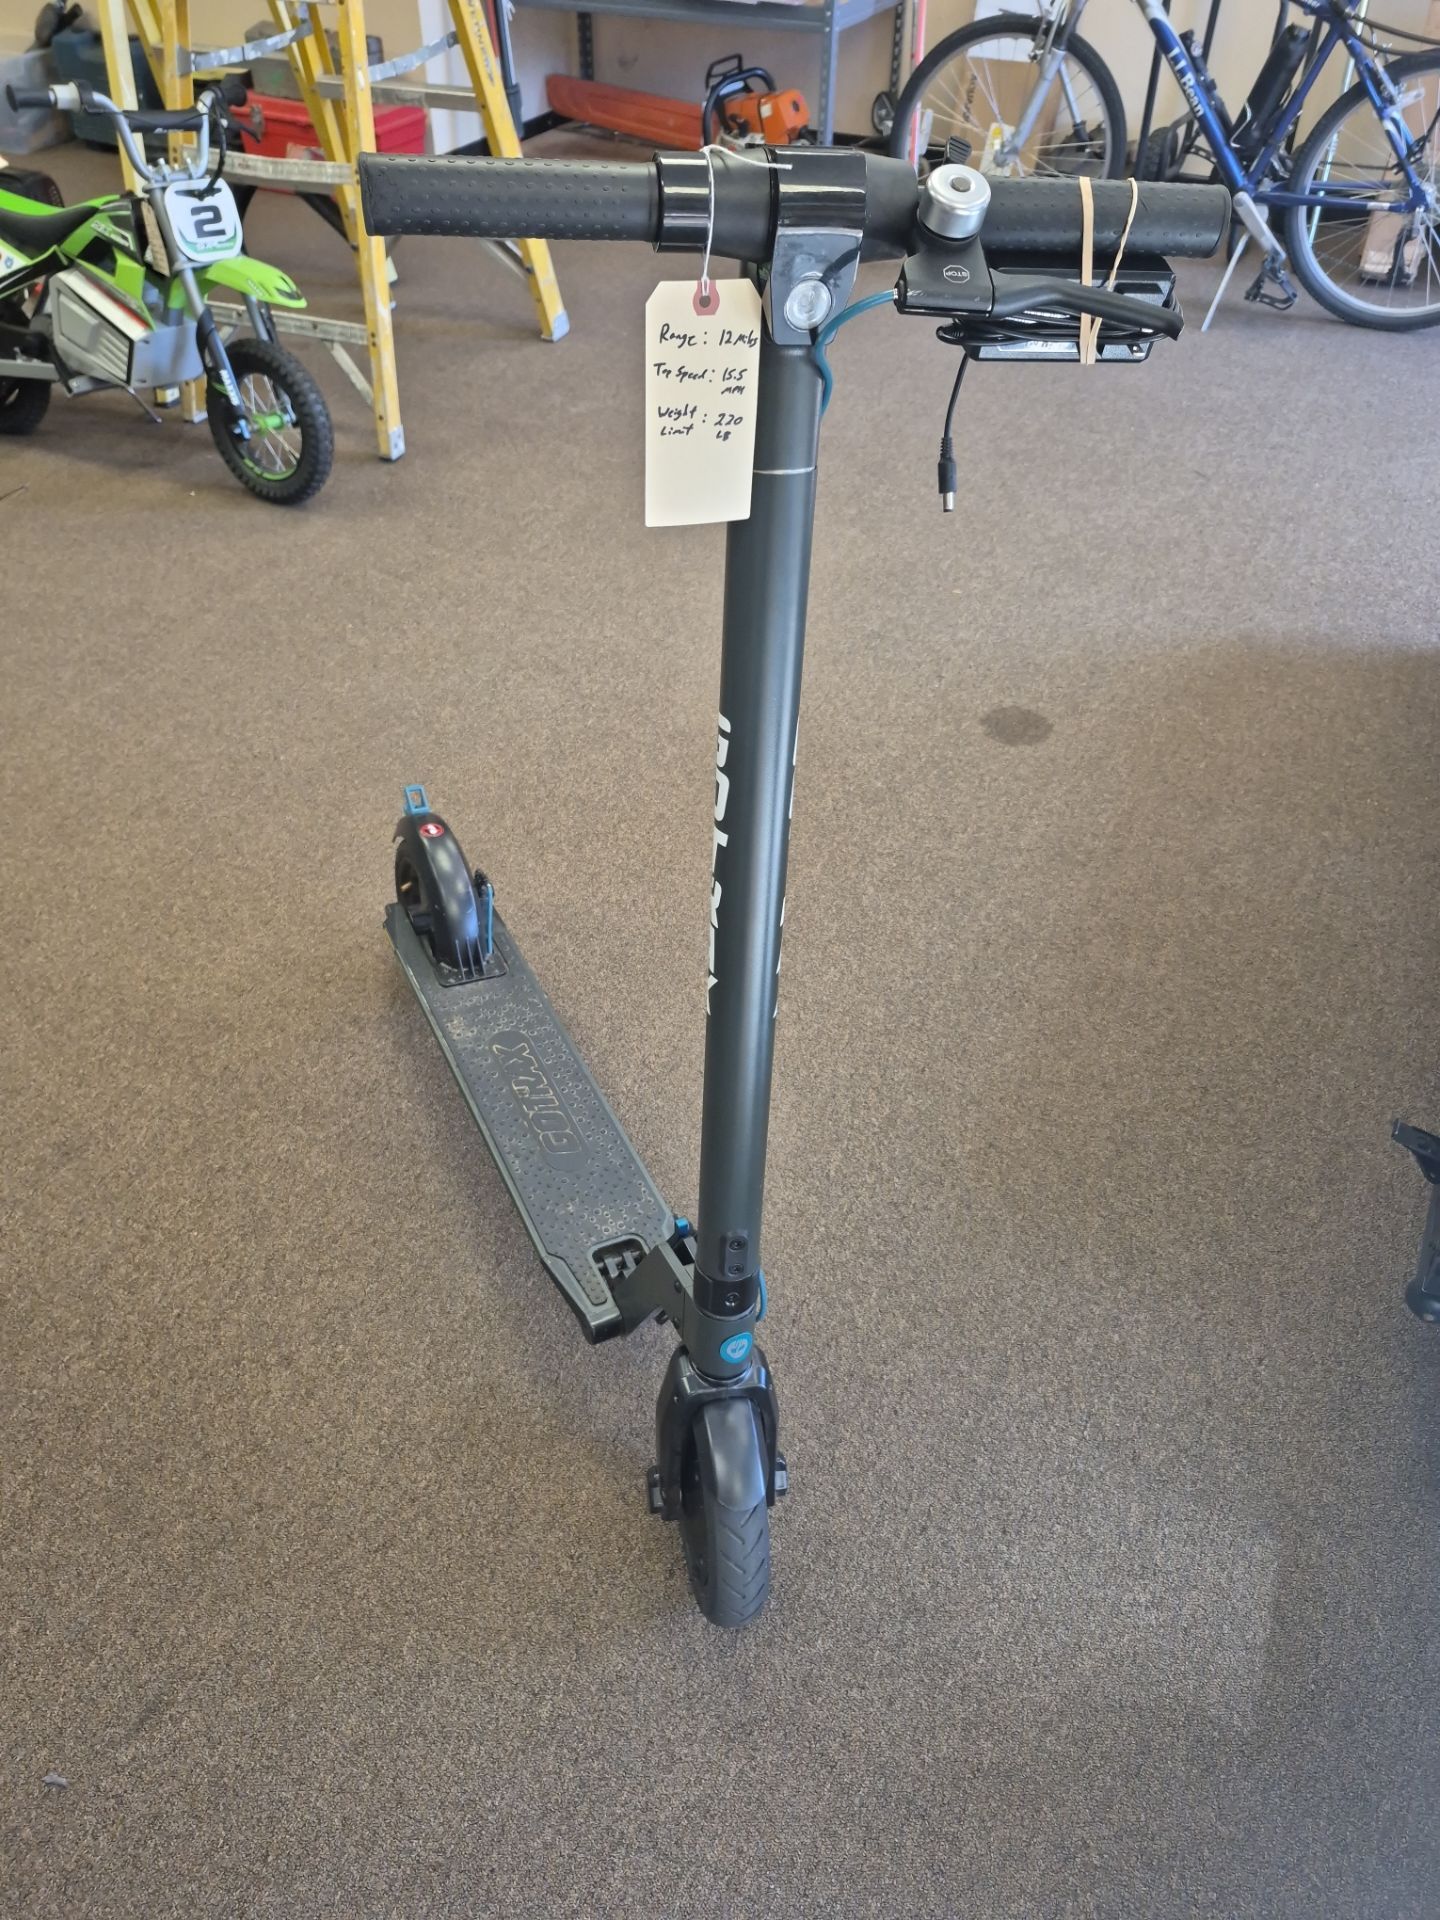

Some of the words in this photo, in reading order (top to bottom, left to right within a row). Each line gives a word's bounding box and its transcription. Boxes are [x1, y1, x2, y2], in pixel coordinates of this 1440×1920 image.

[190, 204, 227, 239] 2
[945, 270, 969, 278] STOP
[718, 328, 733, 347] 12
[653, 362, 672, 379] Top
[721, 366, 748, 383] 15.5
[720, 385, 746, 396] MPH
[713, 412, 744, 427] 220
[660, 423, 695, 437] Limit
[715, 430, 732, 442] LB
